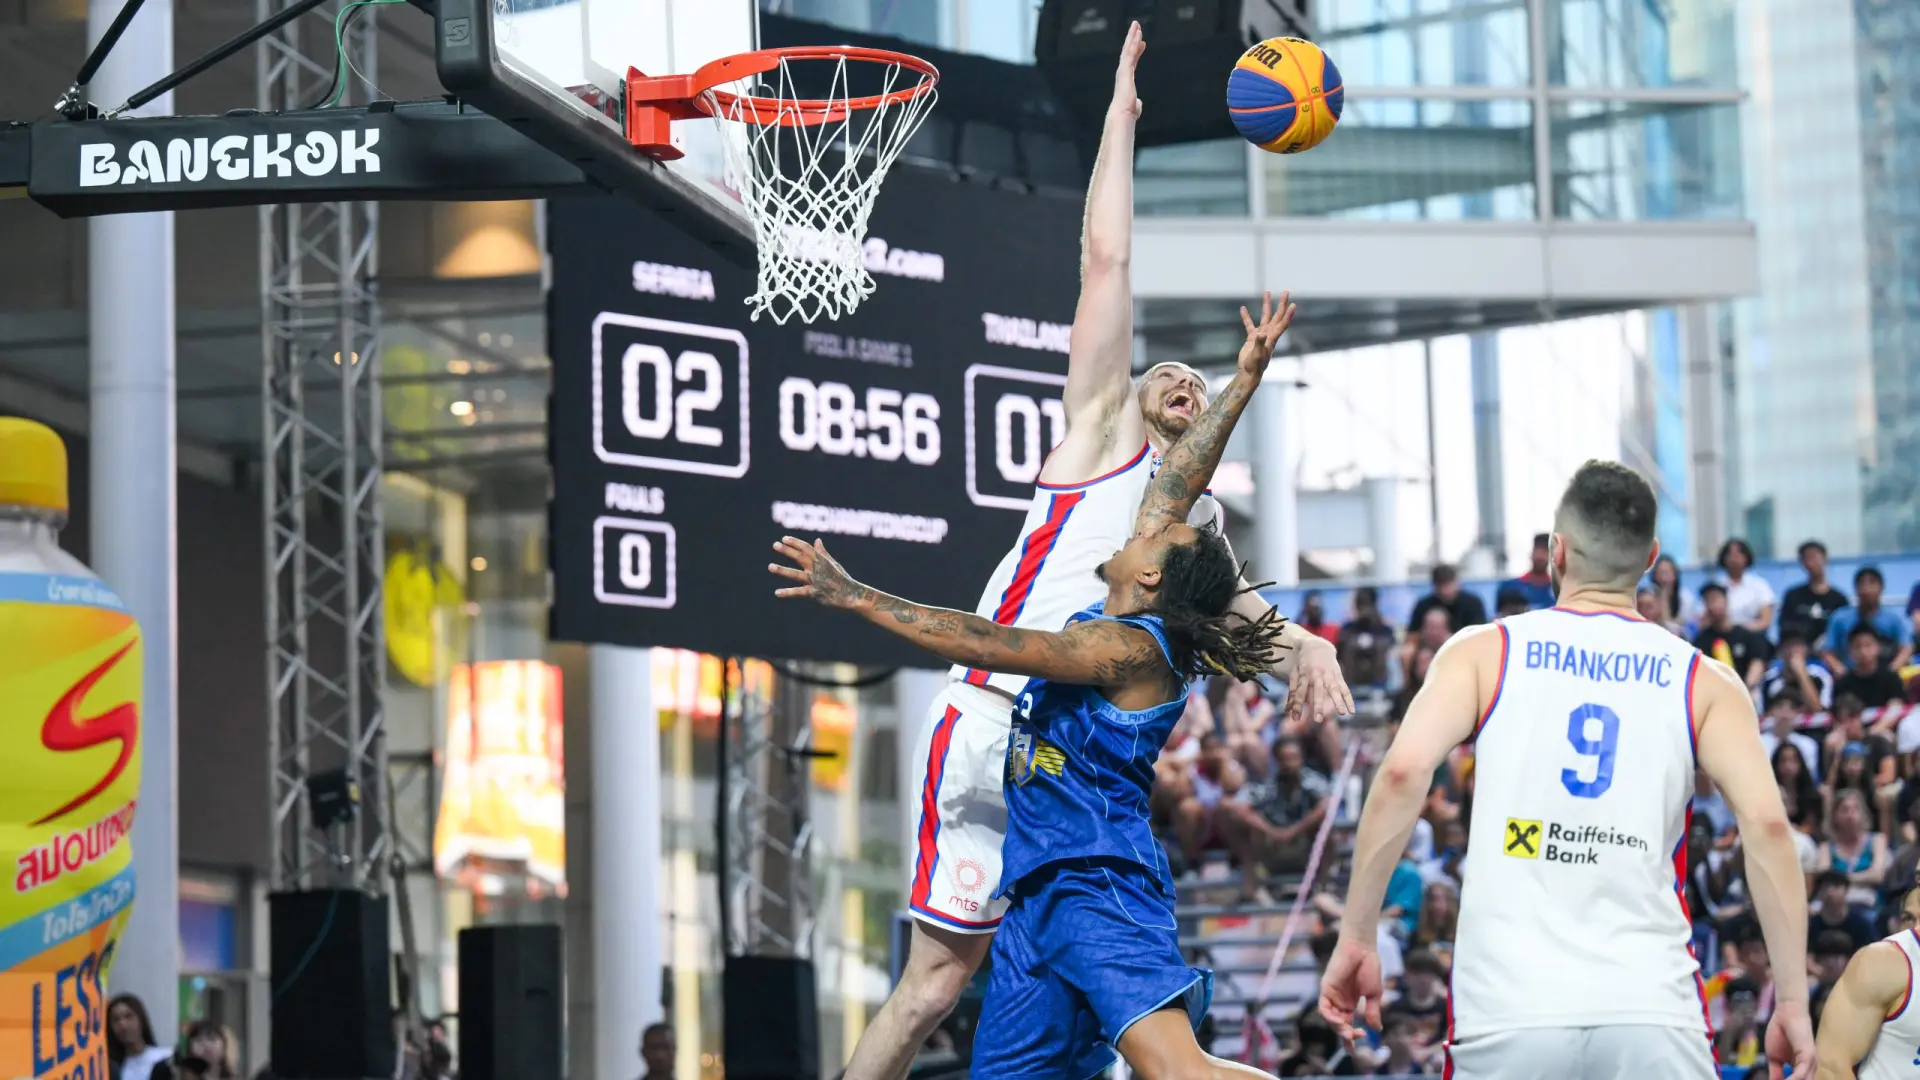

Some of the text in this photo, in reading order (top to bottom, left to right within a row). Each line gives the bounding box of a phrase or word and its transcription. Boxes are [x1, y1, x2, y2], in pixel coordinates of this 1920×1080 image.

[79, 128, 381, 187] BANGKOK
[621, 343, 724, 447] 02
[778, 376, 941, 466] 08:56
[605, 481, 666, 515] FOULS
[619, 532, 651, 590] 0
[1561, 702, 1620, 799] 9
[1545, 844, 1600, 865] Bank
[1548, 822, 1648, 852] Raiffeisen
[949, 895, 979, 912] mts
